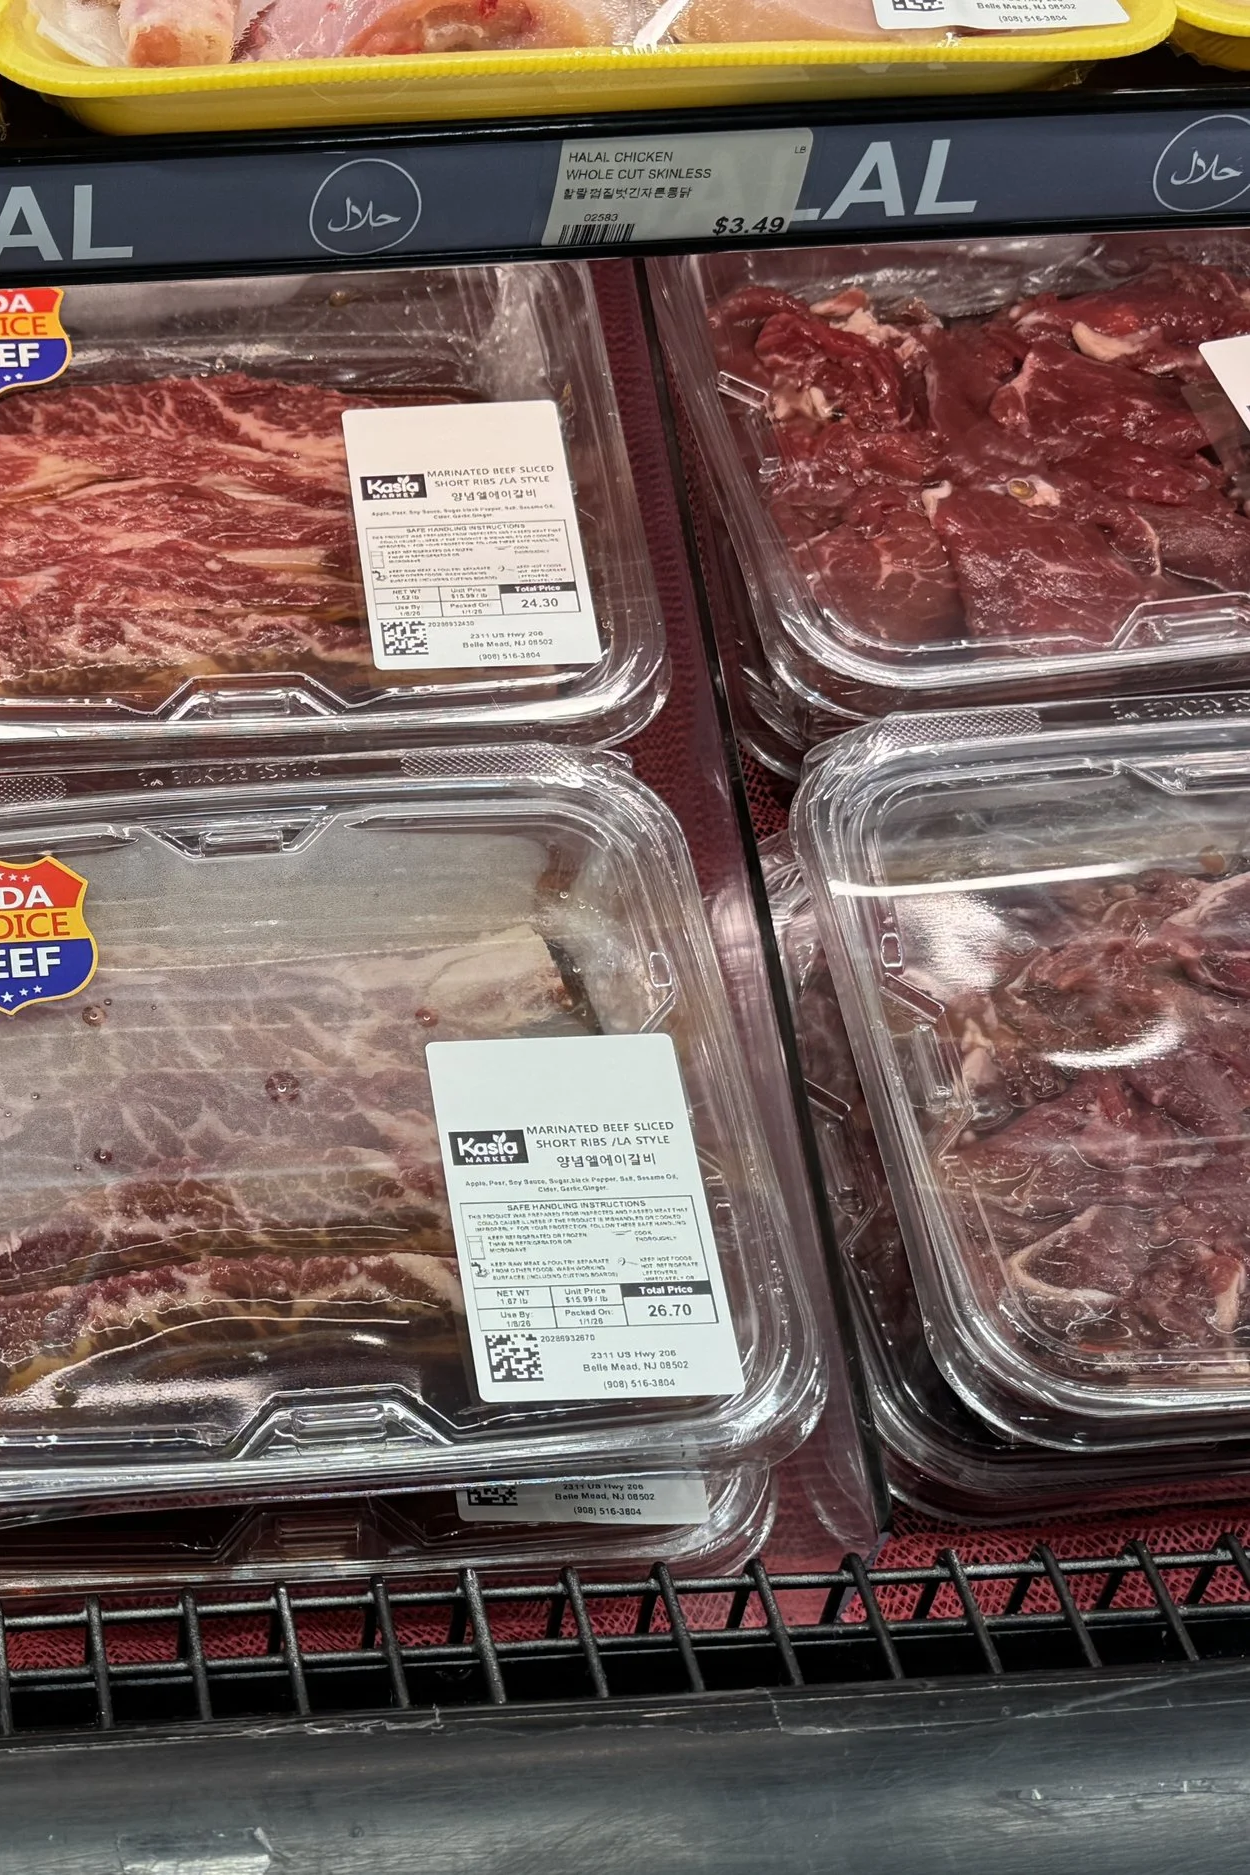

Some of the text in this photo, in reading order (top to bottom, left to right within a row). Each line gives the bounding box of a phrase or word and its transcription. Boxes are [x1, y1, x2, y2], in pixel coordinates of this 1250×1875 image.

[569, 145, 807, 163] HALAL CHICKEN LB
[566, 167, 712, 181] WHOLE CUT SKINLESS
[583, 213, 619, 223] 02583
[712, 217, 786, 236] $3.49
[426, 464, 554, 477] MARINATED BEEF SLICED
[365, 477, 420, 495] Kasia
[434, 475, 550, 487] SHORT RIBS /LA STYLE
[513, 584, 561, 593] Total Price
[520, 597, 559, 608] 24.30
[525, 1121, 675, 1135] MARINATED BEEF SLICED
[456, 1135, 519, 1156] Kasia
[534, 1134, 671, 1149] SHORT RIBS /LA STYLE
[464, 1154, 515, 1163] MARKET
[555, 1151, 656, 1168] 양념엘에이갈비
[506, 1200, 646, 1211] SAFE HANDLING INSTRUCTIONS
[563, 1286, 606, 1295] Unit Price
[637, 1284, 693, 1295] Total Price
[564, 1308, 597, 1317] Packed
[646, 1303, 692, 1317] 26.70
[589, 1350, 656, 1360] 2311 US Hwy
[582, 1360, 689, 1372] Belle Mead, NJ 08502
[602, 1377, 675, 1389] (908) 516-3804
[573, 1506, 597, 1516] (908)
